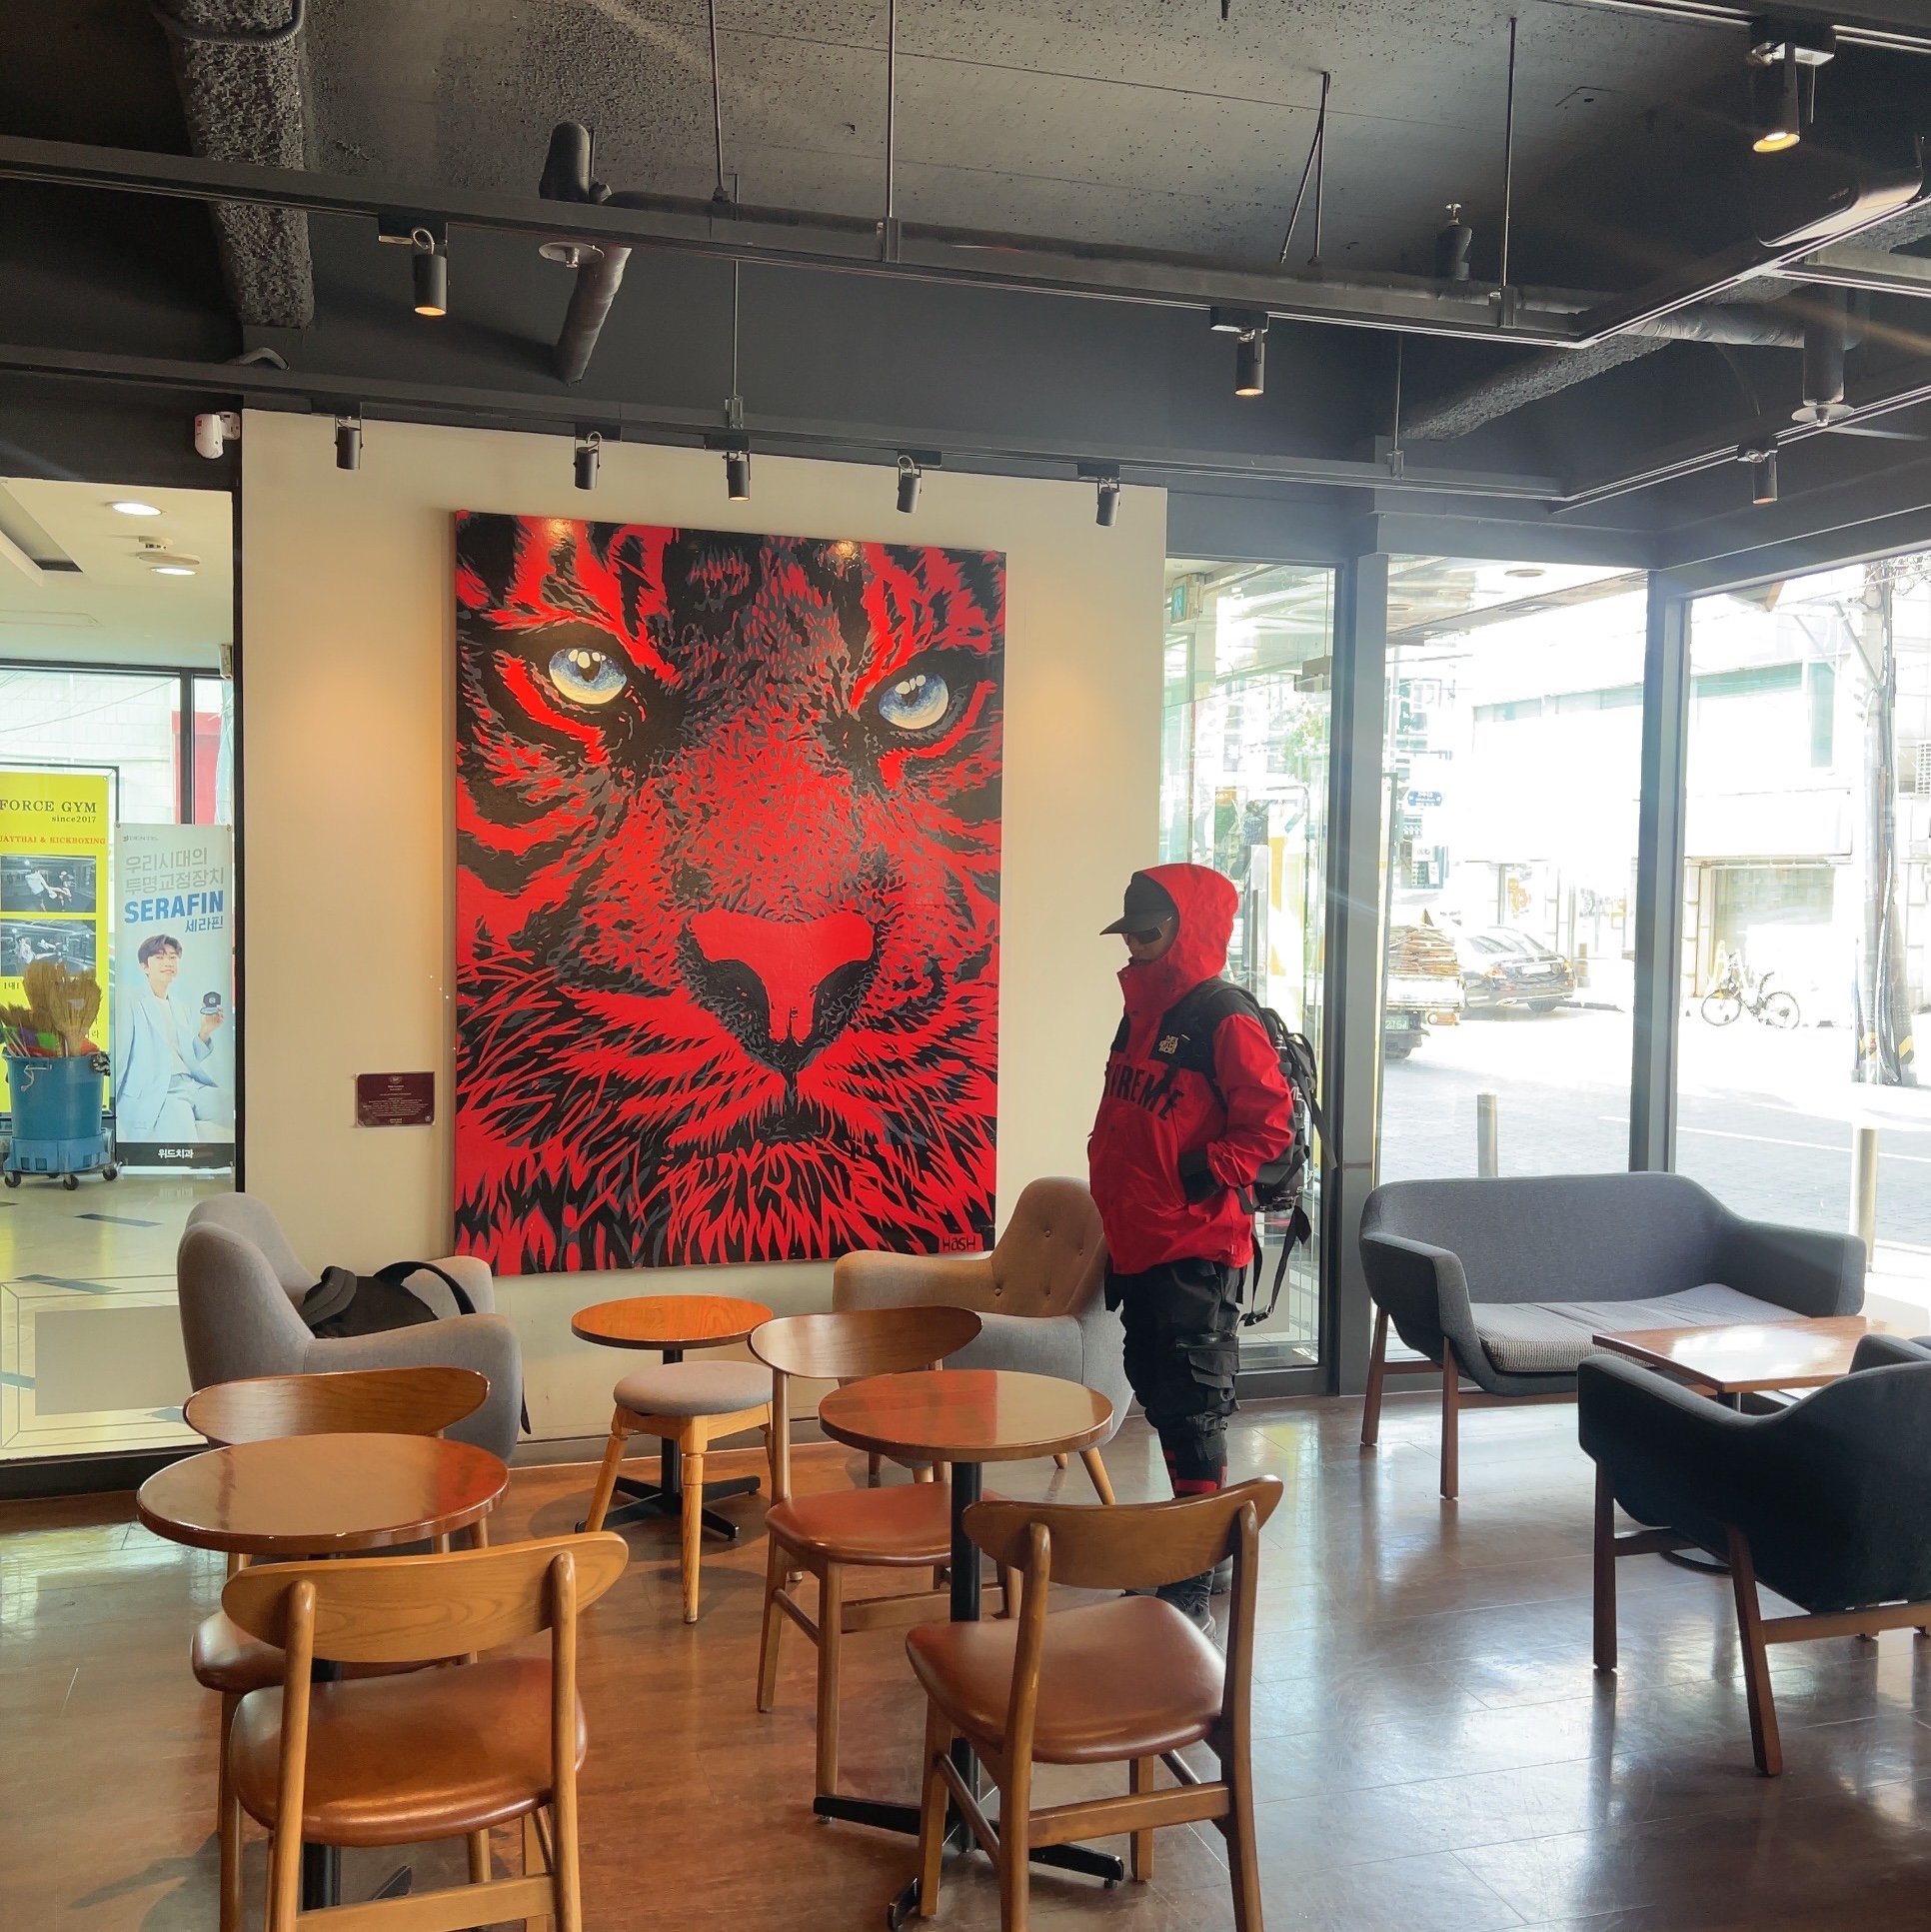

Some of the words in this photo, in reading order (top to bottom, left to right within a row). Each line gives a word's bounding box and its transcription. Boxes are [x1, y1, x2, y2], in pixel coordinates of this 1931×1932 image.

[0, 800, 54, 812] FORCE
[61, 801, 97, 813] GYM
[52, 815, 96, 824] since2017
[125, 848, 208, 874] 우리시대의
[125, 868, 224, 896] 투명교정장치
[124, 890, 224, 924] SERAFIN
[185, 916, 223, 933] 세라핀
[157, 1148, 194, 1159] 위드치과
